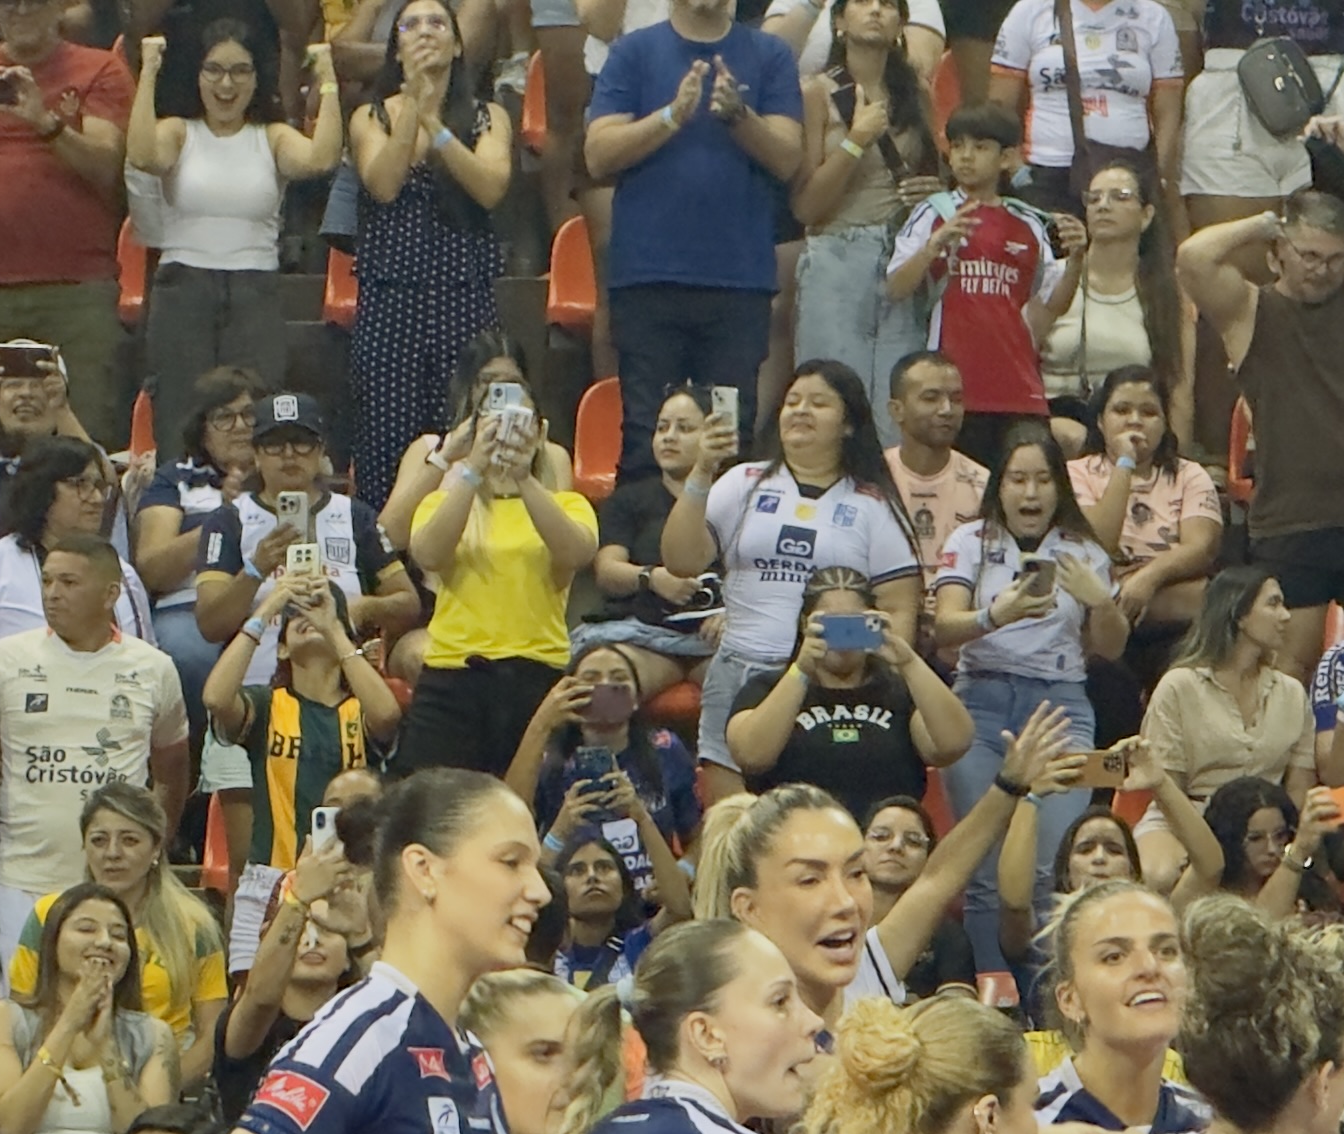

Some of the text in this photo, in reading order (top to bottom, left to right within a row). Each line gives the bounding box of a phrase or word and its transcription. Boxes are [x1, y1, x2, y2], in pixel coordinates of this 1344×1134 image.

[753, 558, 818, 574] GERDA
[759, 569, 806, 583] min
[795, 704, 893, 731] BRASIL
[25, 745, 67, 764] São
